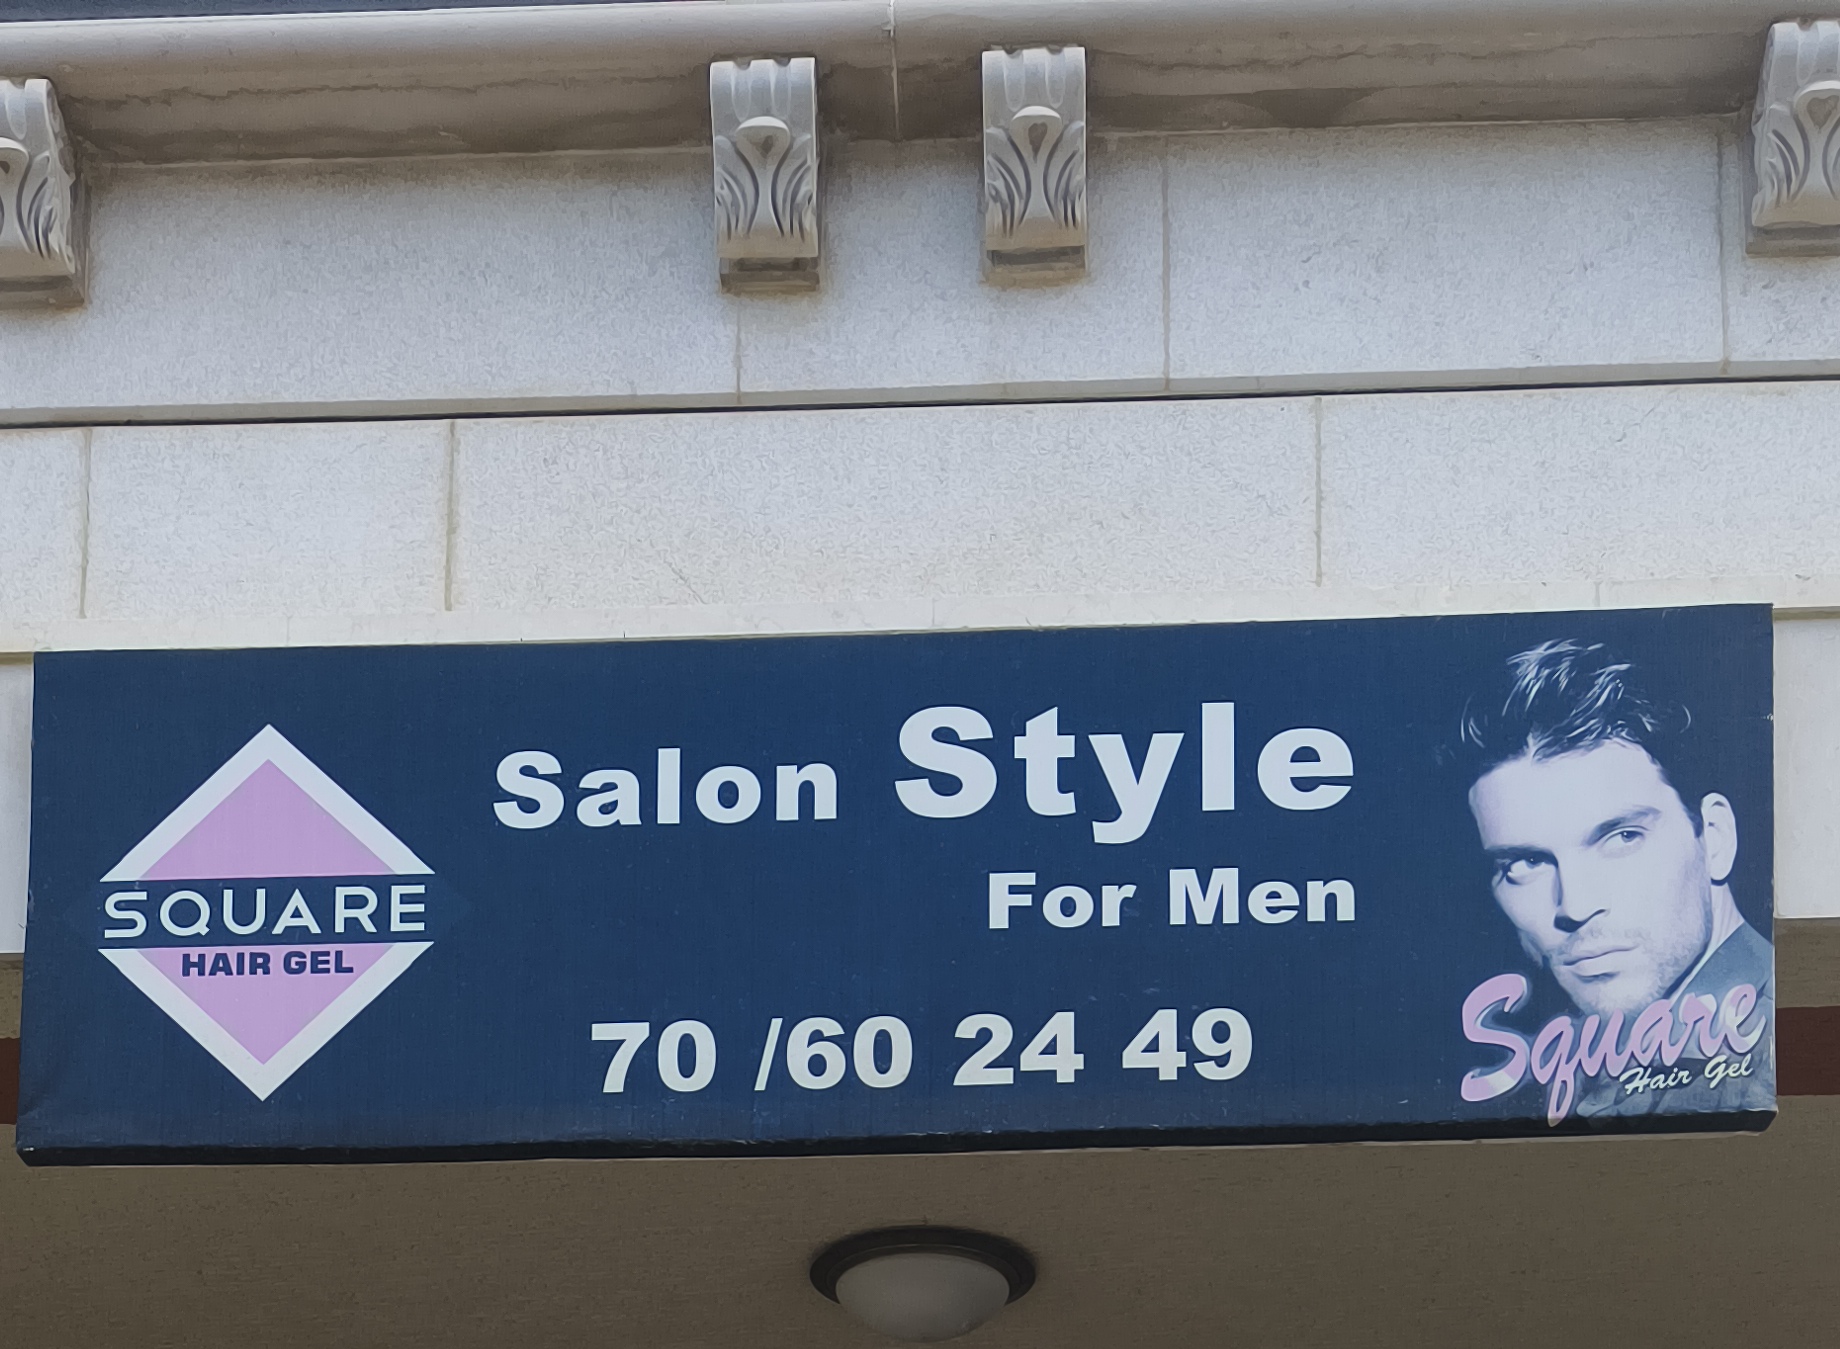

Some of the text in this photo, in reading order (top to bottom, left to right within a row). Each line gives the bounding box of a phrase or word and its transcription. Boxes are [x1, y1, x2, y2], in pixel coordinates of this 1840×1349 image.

[492, 701, 1355, 844] Salon Style
[103, 883, 427, 939] SQUARE
[988, 867, 1356, 929] For Men
[181, 949, 354, 977] HAIR GEL
[590, 1019, 717, 1094] 70
[953, 1011, 1084, 1086] 24
[1122, 1008, 1254, 1080] 49
[1460, 973, 1766, 1128] Square
[1619, 1054, 1754, 1096] Hair Gel
